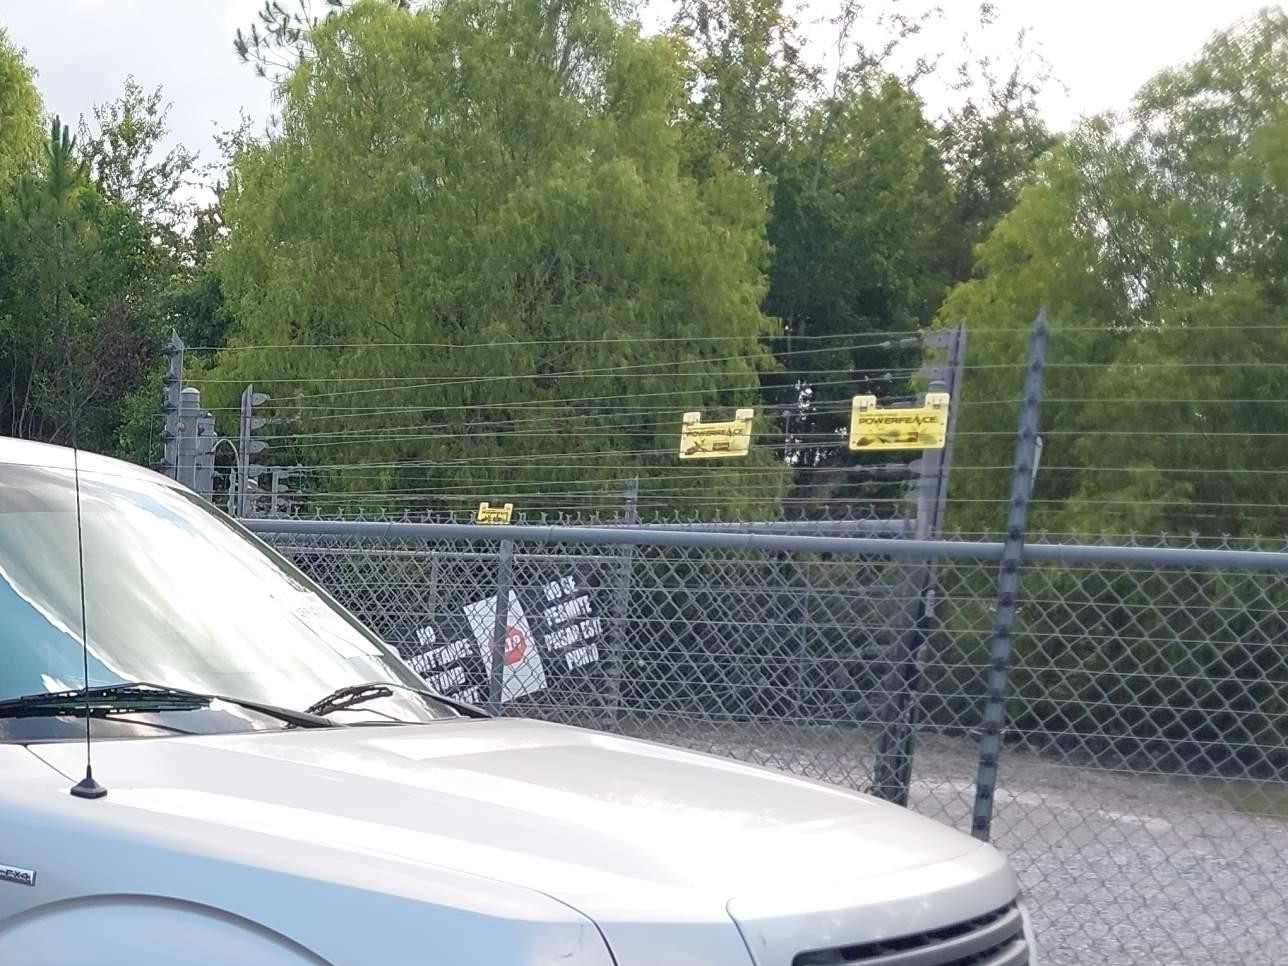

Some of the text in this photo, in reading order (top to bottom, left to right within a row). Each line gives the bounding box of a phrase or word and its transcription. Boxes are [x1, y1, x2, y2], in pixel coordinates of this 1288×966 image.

[543, 575, 578, 601] NO SE
[544, 595, 593, 626] PERMITE
[416, 625, 436, 647] NO
[544, 624, 580, 652] PASAR
[406, 638, 473, 674] MITTANCE
[565, 642, 599, 670] PUNTO
[425, 666, 466, 693] YOND
